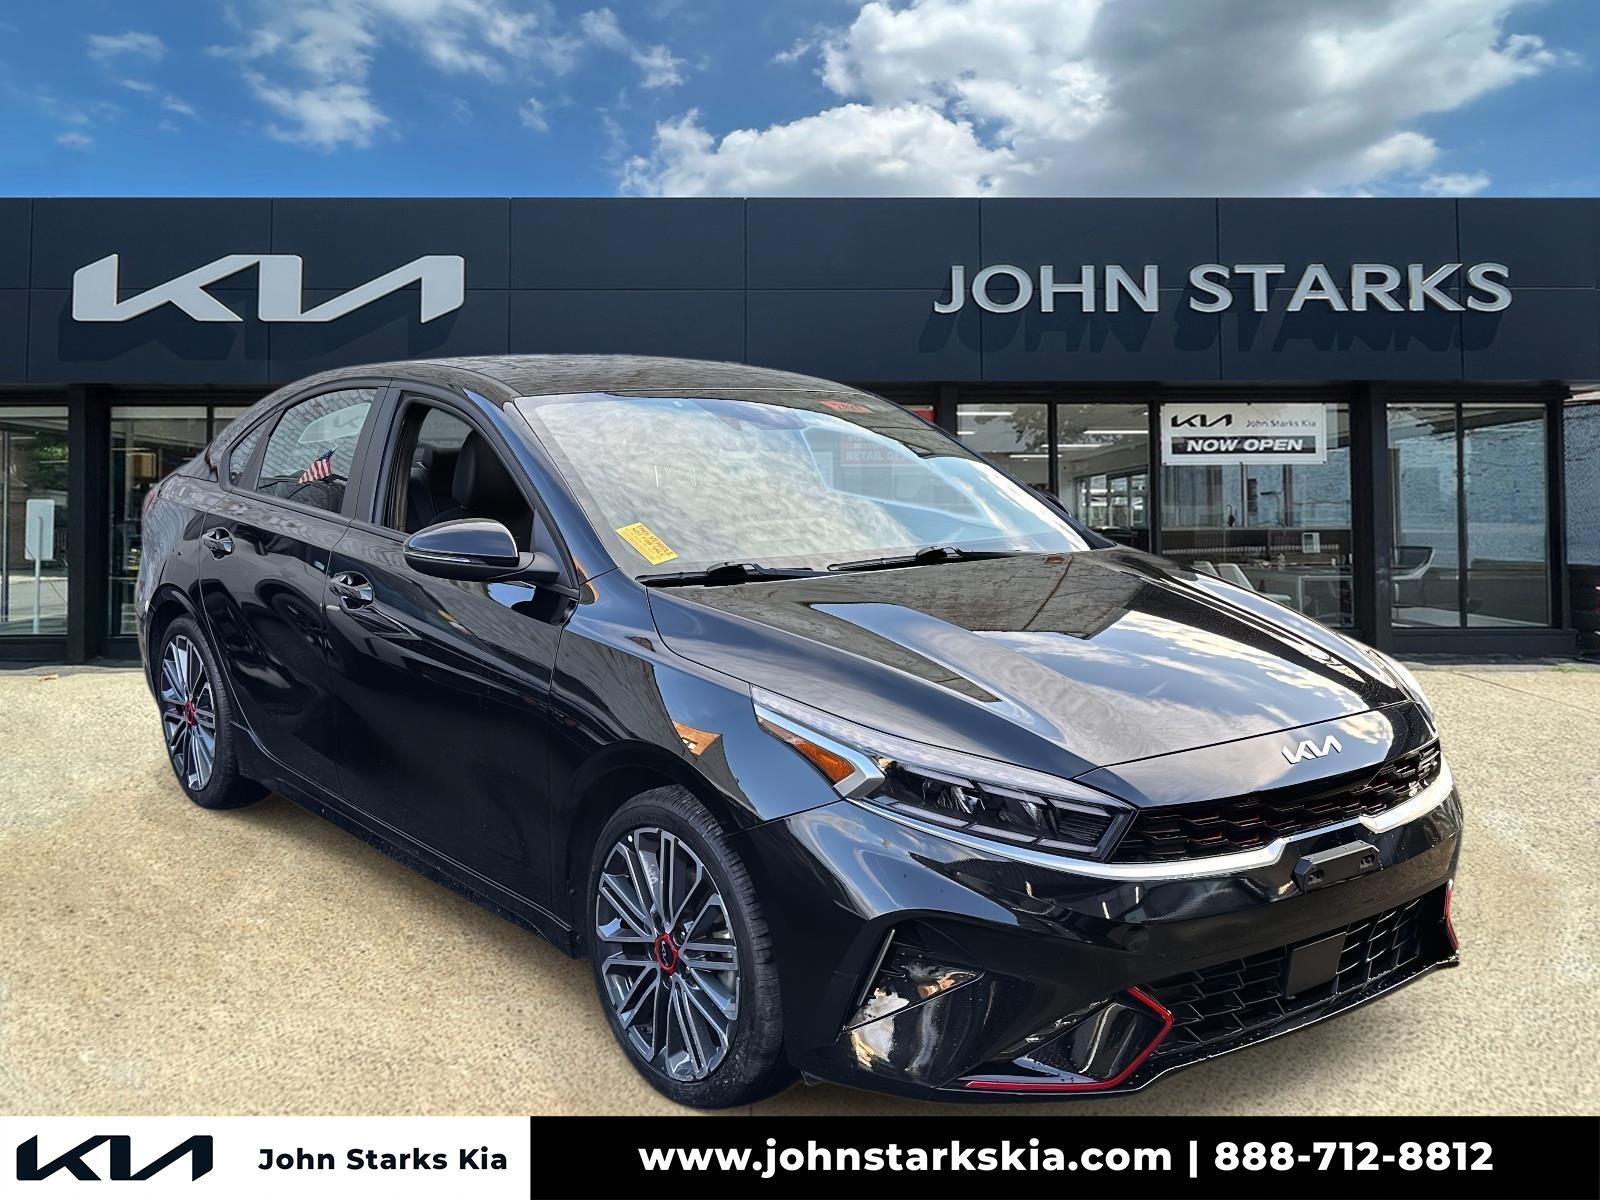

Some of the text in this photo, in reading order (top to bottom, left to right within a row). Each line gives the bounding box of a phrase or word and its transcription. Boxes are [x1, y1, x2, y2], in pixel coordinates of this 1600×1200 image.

[72, 253, 465, 324] KIA
[933, 262, 1512, 314] JOHN STARKS
[1171, 413, 1233, 428] KIA
[1246, 419, 1316, 427] John Starks Kia
[1186, 439, 1303, 451] NOW OPEN
[1282, 735, 1342, 764] KIA
